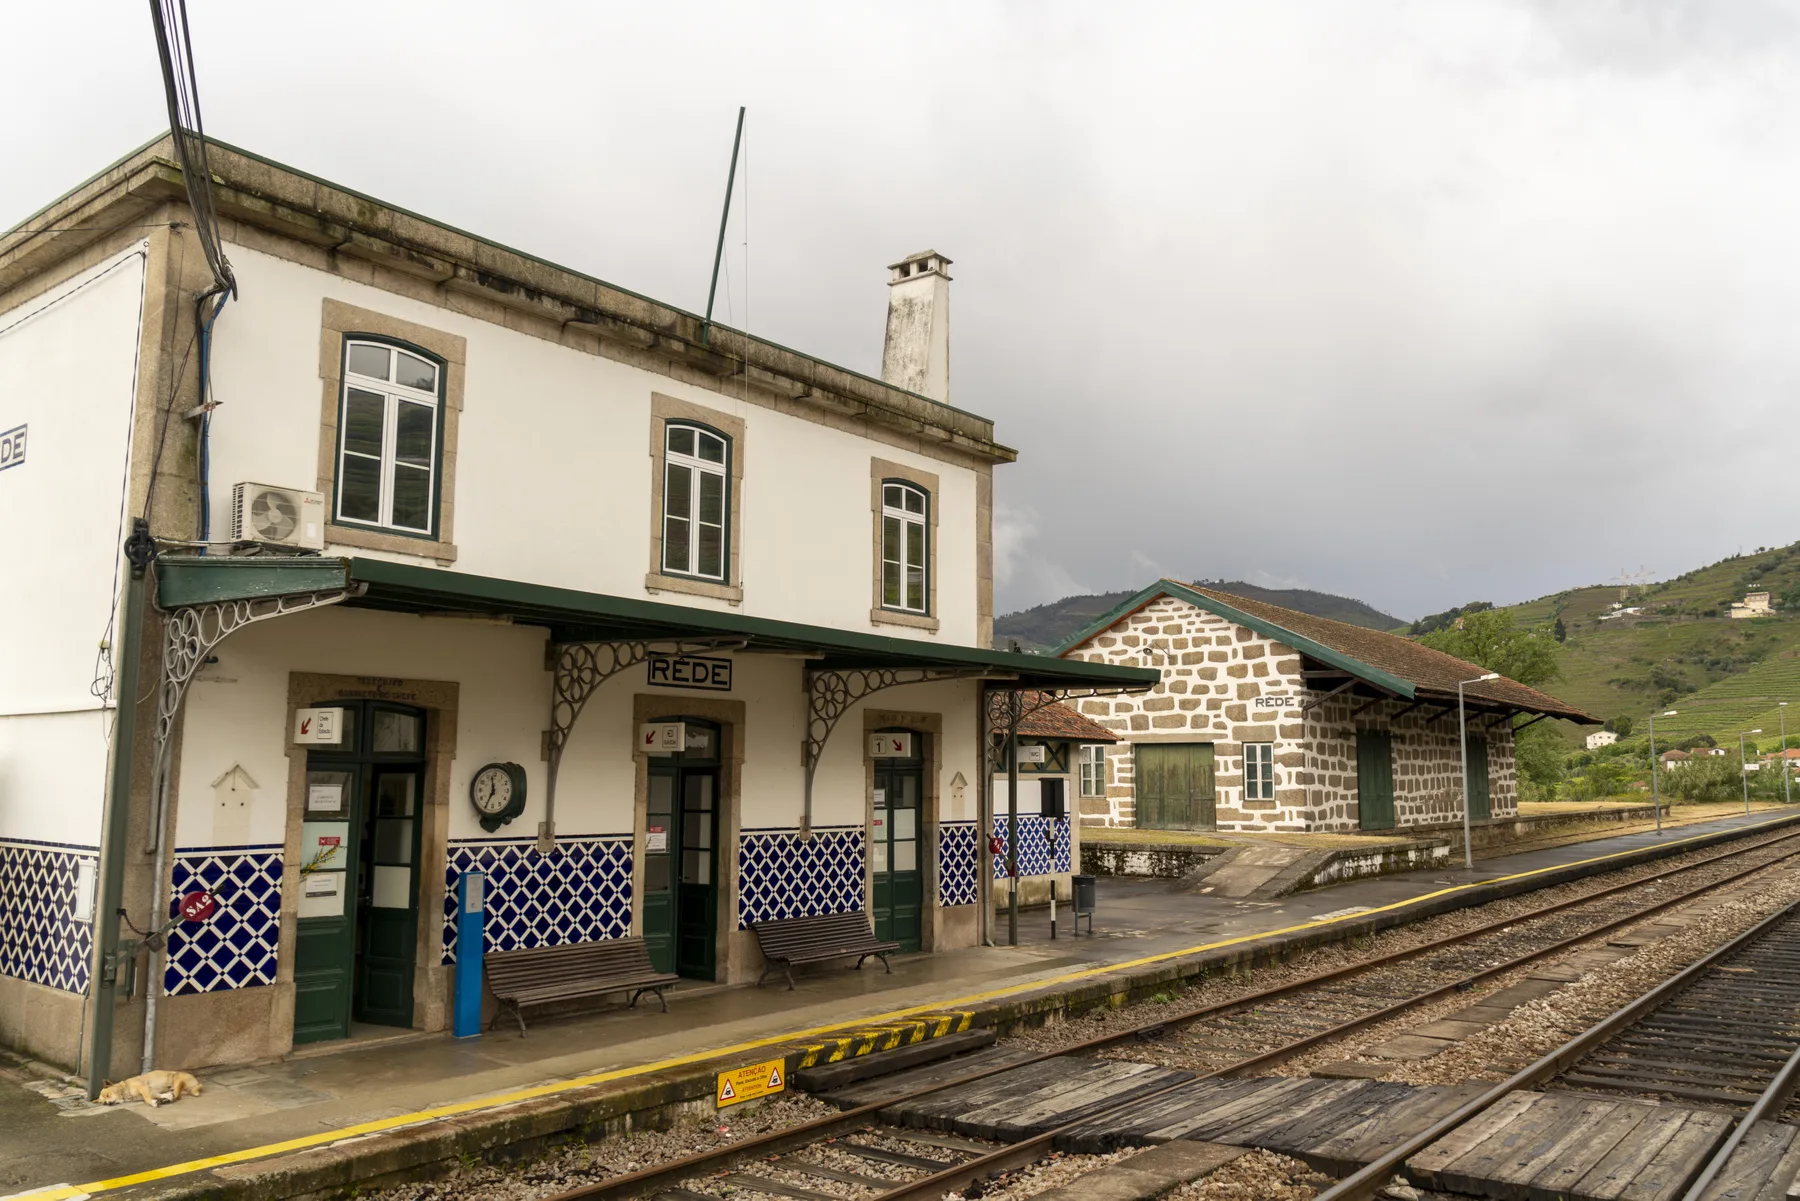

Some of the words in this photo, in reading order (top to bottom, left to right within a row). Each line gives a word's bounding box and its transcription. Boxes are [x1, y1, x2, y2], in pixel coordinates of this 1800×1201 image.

[652, 657, 729, 686] RÊDE
[876, 742, 881, 753] 1
[186, 894, 212, 917] SA2
